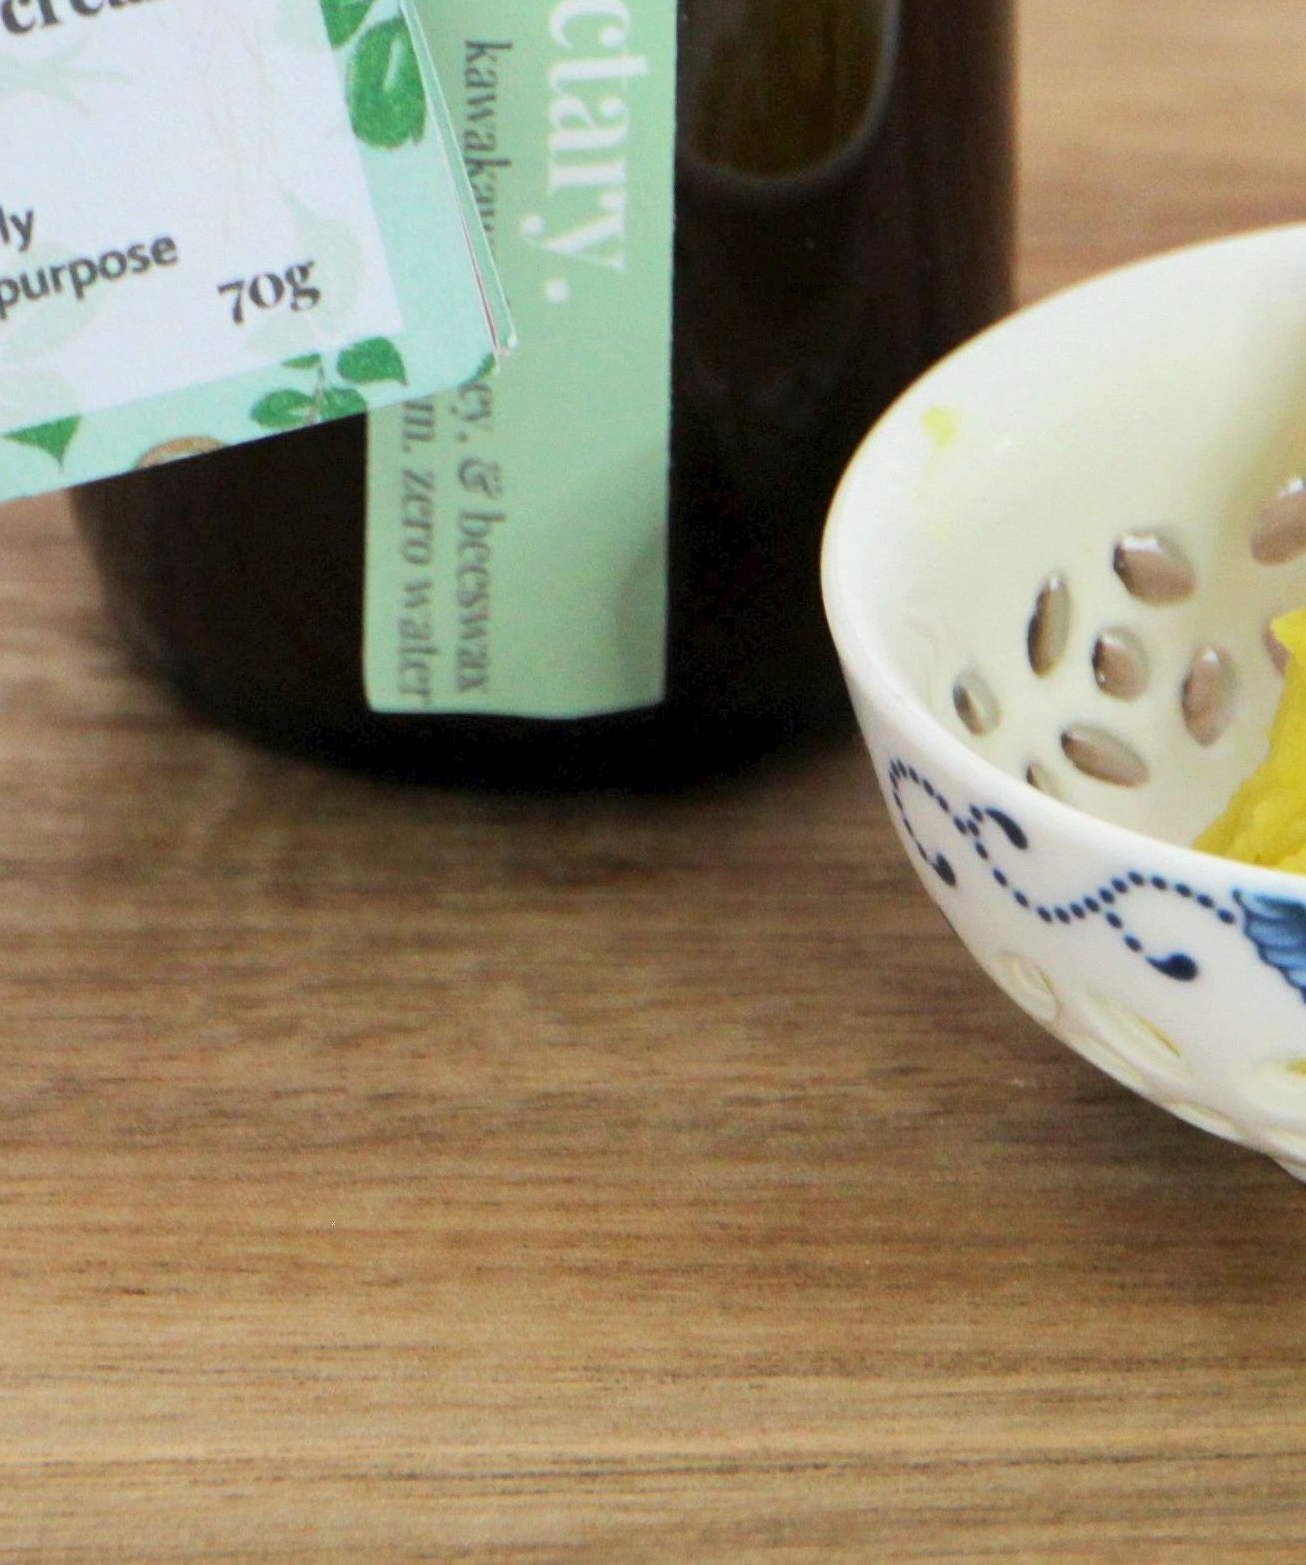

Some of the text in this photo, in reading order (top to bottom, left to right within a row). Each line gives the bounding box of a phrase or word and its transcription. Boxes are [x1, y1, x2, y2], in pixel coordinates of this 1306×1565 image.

[216, 259, 322, 325] 70g
[399, 469, 436, 566] zero
[395, 578, 441, 709] water
[453, 510, 507, 696] beeswax
